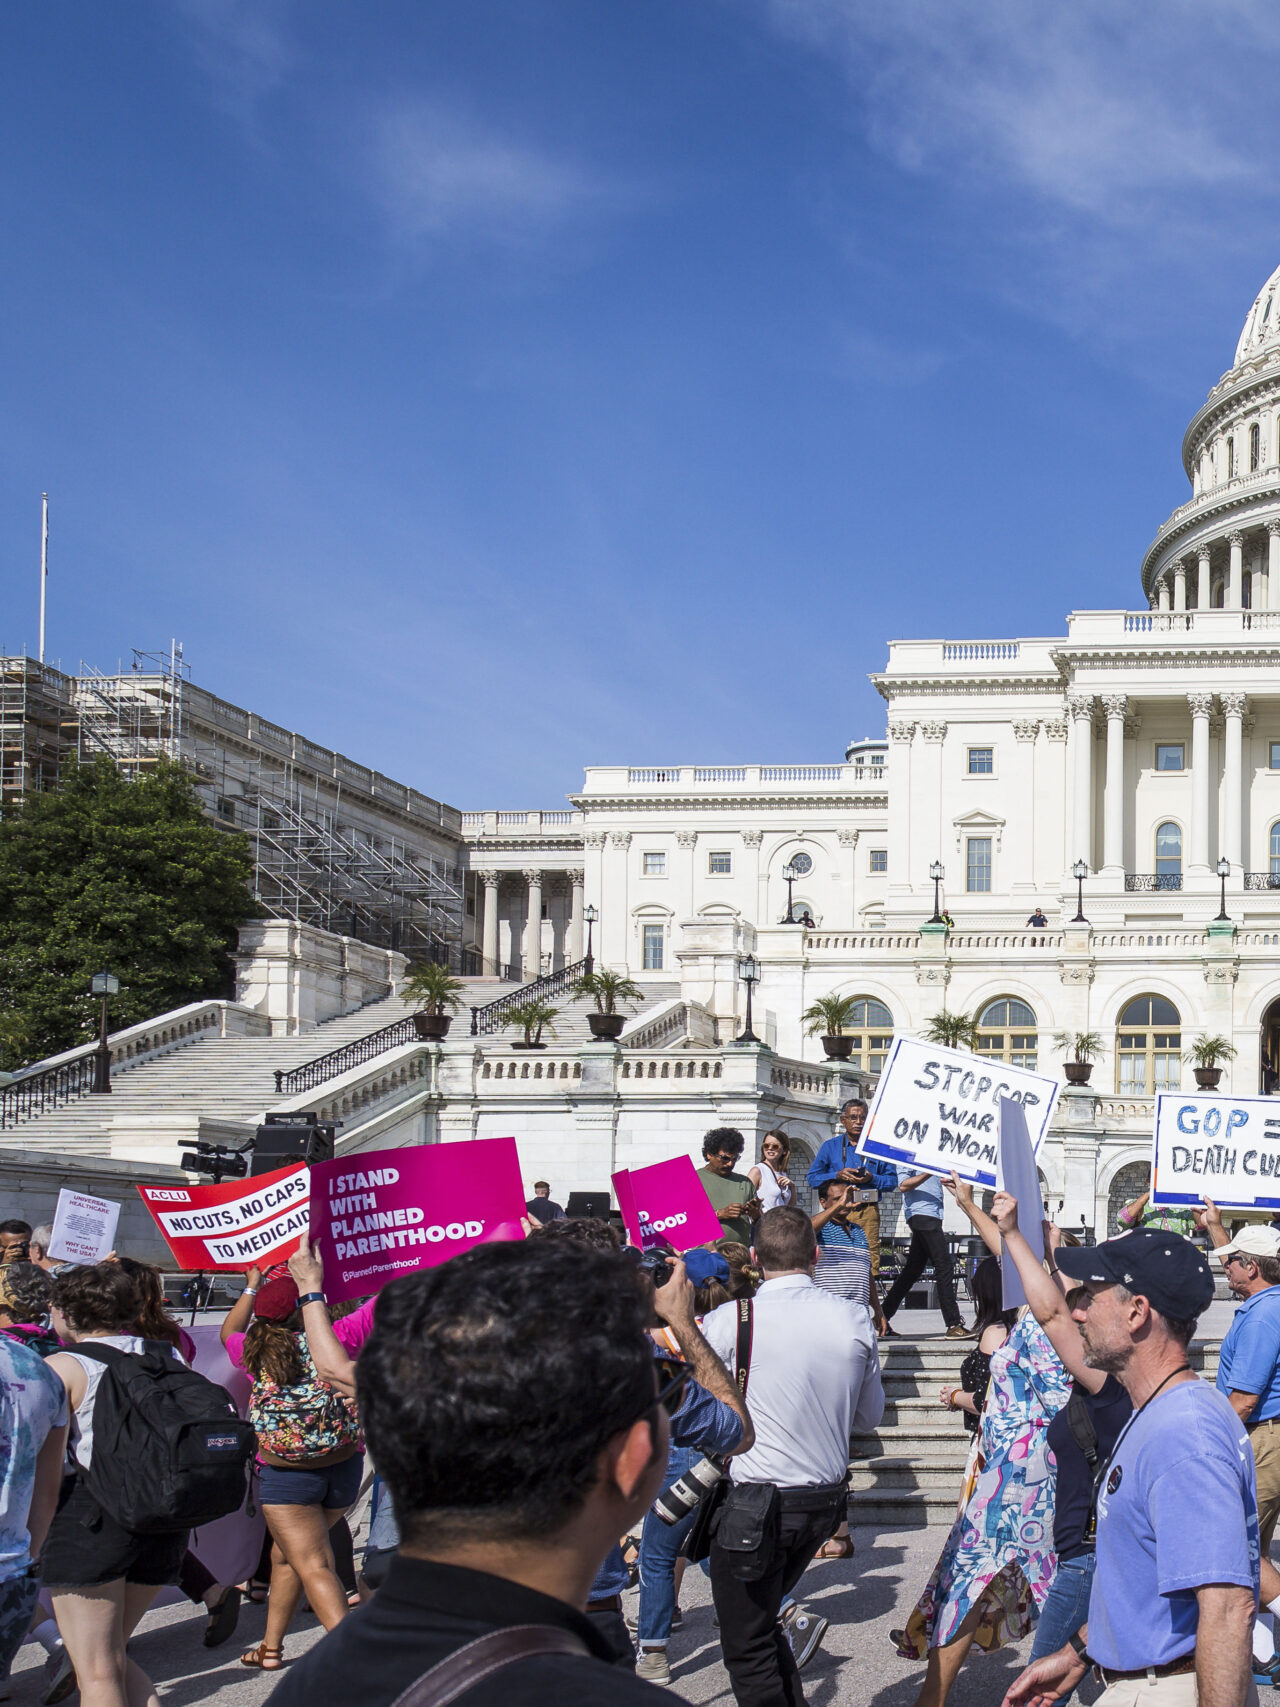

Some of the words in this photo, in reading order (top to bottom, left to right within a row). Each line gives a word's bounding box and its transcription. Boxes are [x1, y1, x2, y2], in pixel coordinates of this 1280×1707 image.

[914, 1061, 992, 1102] STOP
[893, 1117, 930, 1144] ON
[938, 1102, 995, 1133] WAR
[1177, 1105, 1250, 1139] GOP
[1172, 1144, 1237, 1175] DEATH
[150, 1190, 188, 1201] ACLU
[328, 1178, 334, 1196] I
[337, 1167, 400, 1194] STAND
[69, 1200, 111, 1214] HEALTHCARE
[74, 1195, 108, 1207] UNIVERSAL
[169, 1217, 193, 1232] NO
[194, 1210, 240, 1230] CUTS,
[239, 1199, 264, 1220] NO
[264, 1177, 307, 1207] CAPS
[329, 1191, 377, 1217] WITH
[213, 1244, 235, 1258] TO
[236, 1208, 310, 1256] MEDICAID
[330, 1207, 425, 1239] PLANNED
[65, 1240, 79, 1248] WHY
[80, 1244, 99, 1253] CAN'T
[79, 1249, 96, 1258] USA?
[335, 1220, 484, 1261] PARENTHOOD
[349, 1267, 373, 1280] Planned
[372, 1257, 421, 1274] Parenthood
